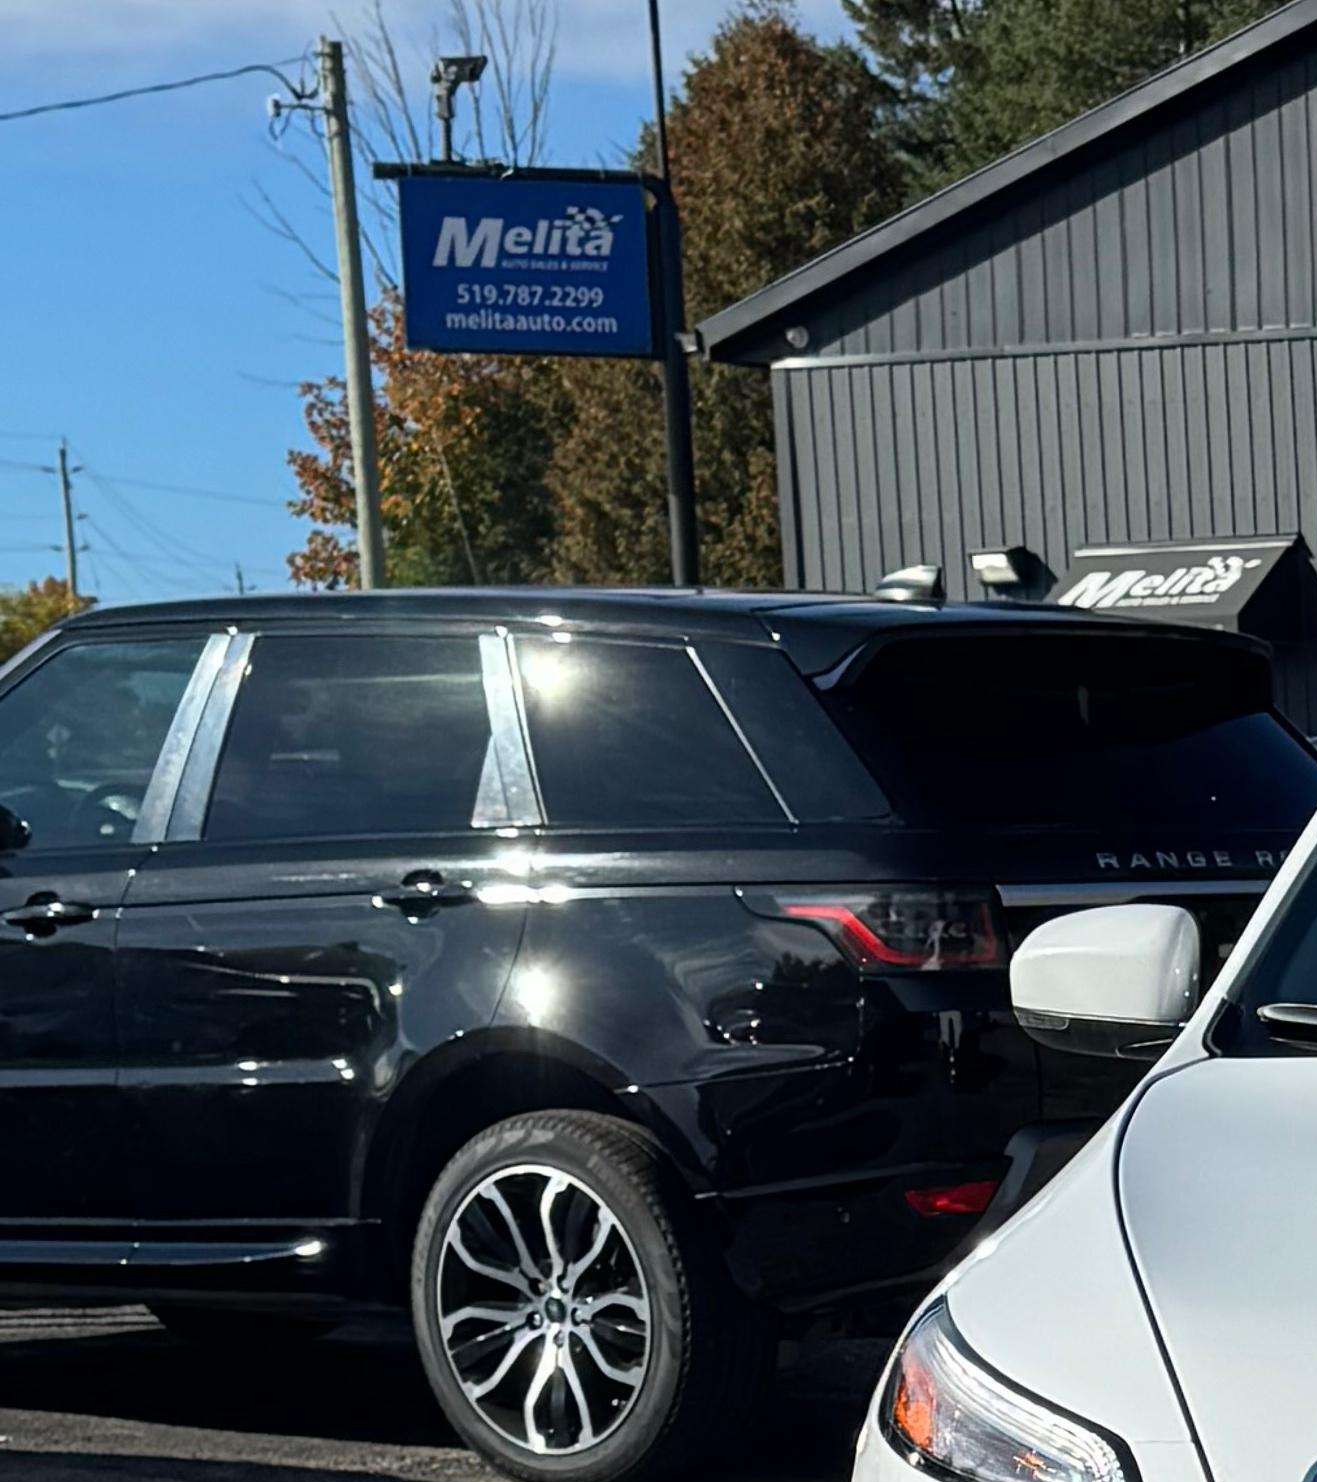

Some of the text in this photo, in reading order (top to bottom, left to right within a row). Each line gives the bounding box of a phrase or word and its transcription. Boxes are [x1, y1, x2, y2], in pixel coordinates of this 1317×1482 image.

[432, 215, 614, 268] Melita
[456, 284, 604, 308] 519.787.2299
[445, 309, 618, 333] melitaauto.com
[1096, 850, 1232, 869] RANGE
